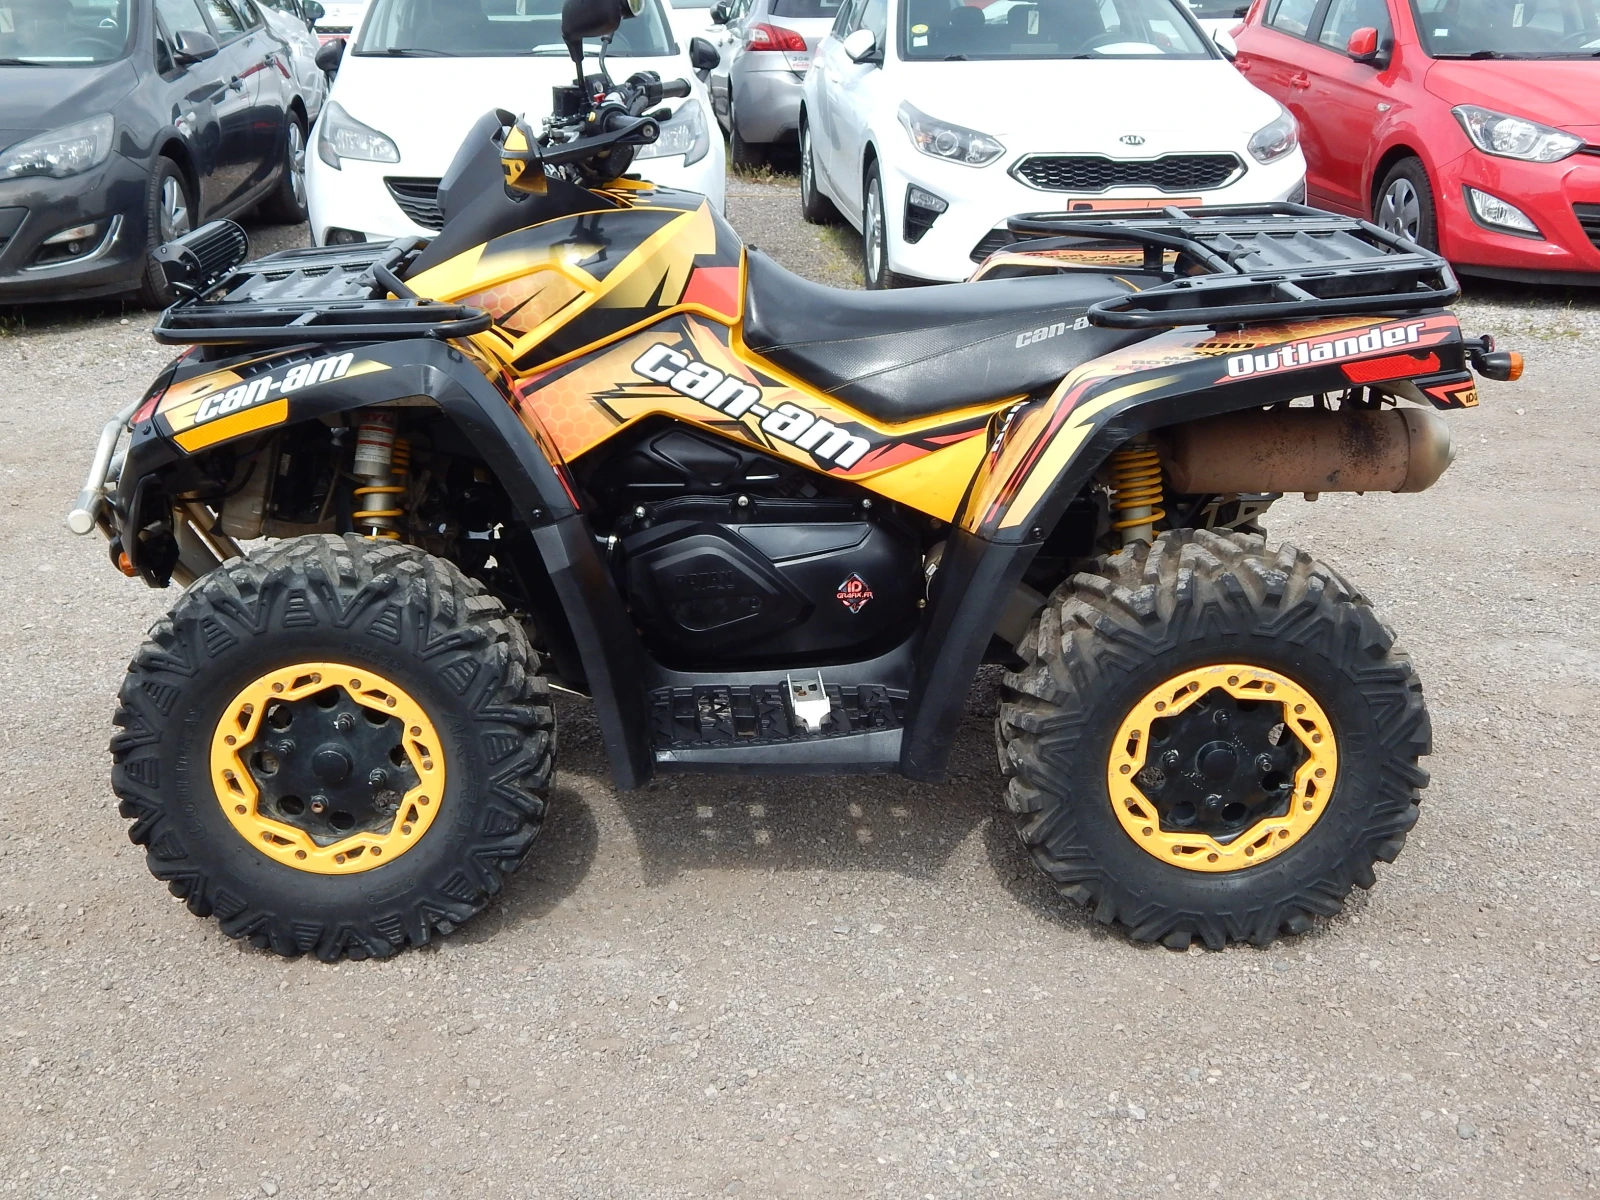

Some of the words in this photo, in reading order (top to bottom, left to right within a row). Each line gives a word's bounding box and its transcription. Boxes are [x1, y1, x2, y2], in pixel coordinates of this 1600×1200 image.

[1121, 135, 1145, 144] KIA
[1227, 322, 1424, 377] Outlander
[194, 352, 354, 424] can-am
[632, 343, 871, 469] can-am
[848, 581, 862, 592] ID
